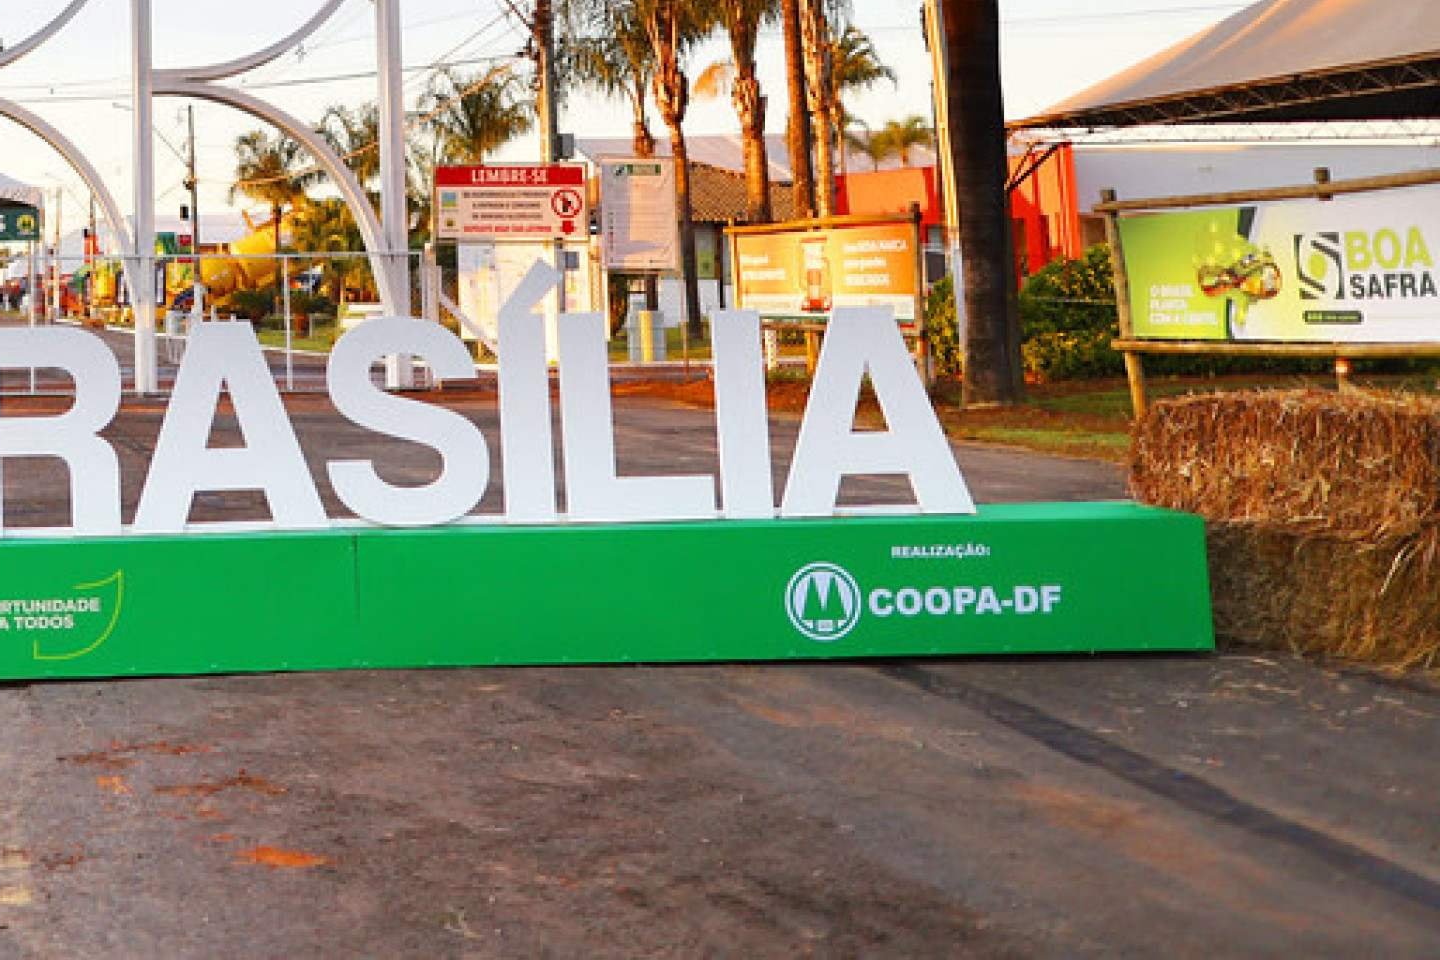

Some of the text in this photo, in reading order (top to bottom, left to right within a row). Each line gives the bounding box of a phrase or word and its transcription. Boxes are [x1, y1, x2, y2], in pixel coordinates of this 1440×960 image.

[471, 169, 548, 183] LEMBRE-SE
[1344, 225, 1434, 271] BOA
[1349, 271, 1438, 300] SAFRA
[891, 541, 991, 558] REALIZAÇÃO:
[868, 585, 1062, 617] COOPA-DF
[13, 615, 74, 630] TODOS
